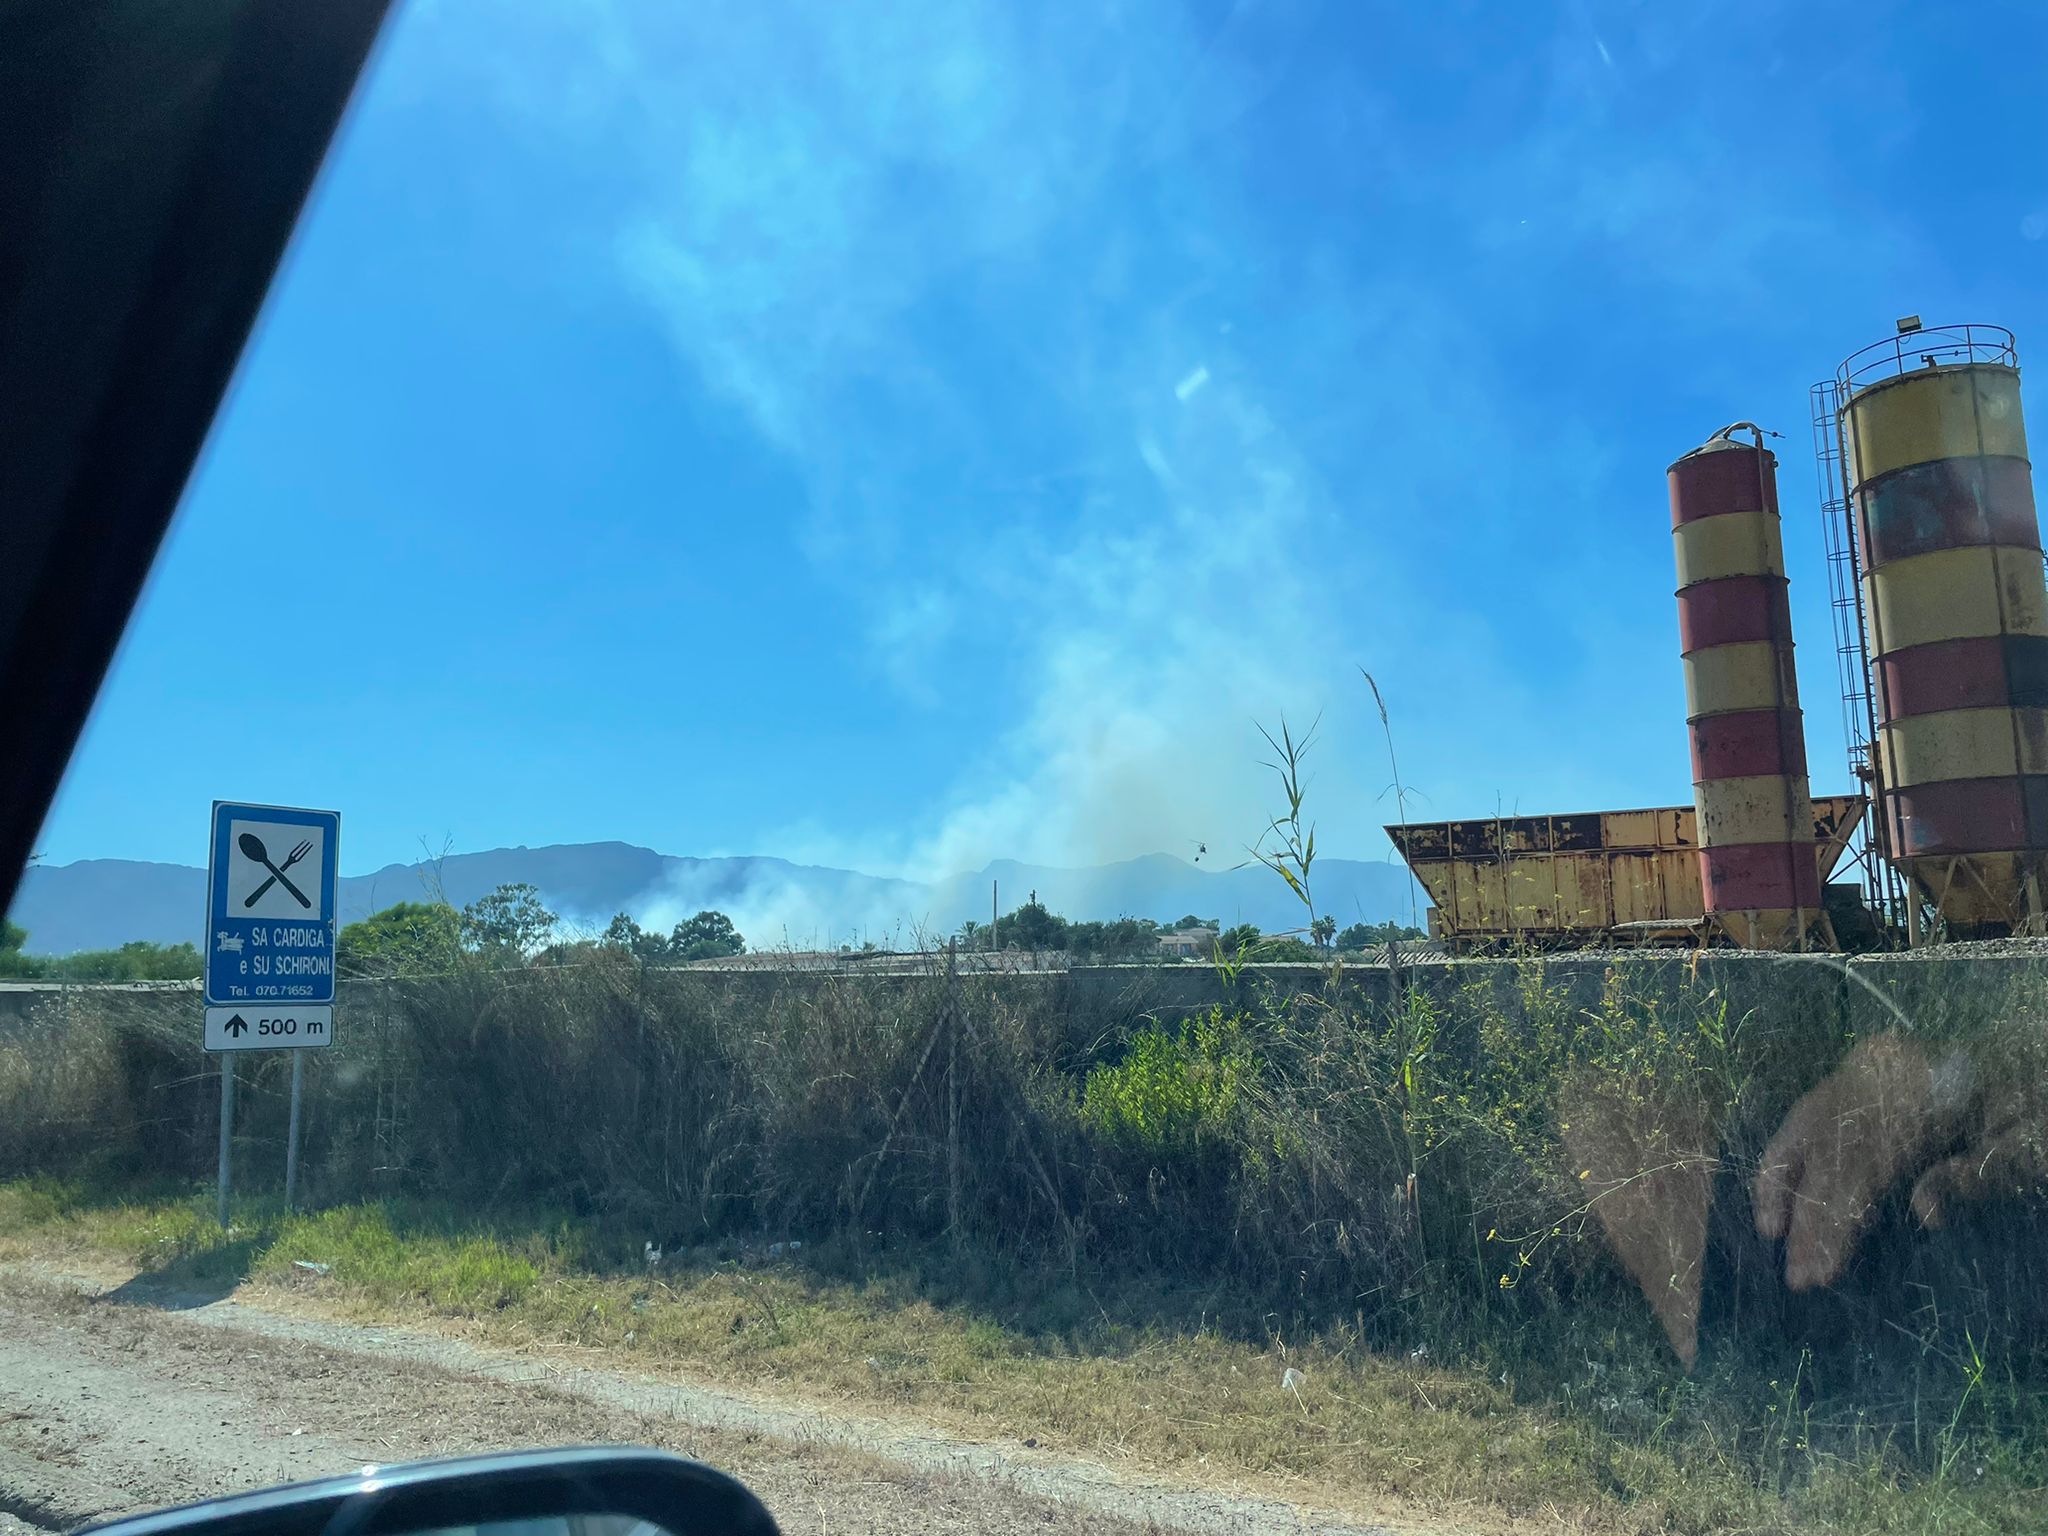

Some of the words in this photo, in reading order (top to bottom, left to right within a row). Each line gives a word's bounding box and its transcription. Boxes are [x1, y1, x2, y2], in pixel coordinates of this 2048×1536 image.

[252, 927, 268, 946] SA
[273, 928, 325, 947] CARDIGA
[240, 960, 247, 974] e
[254, 955, 269, 974] SU
[275, 955, 331, 975] SCHIRONI
[258, 1019, 297, 1035] 500
[307, 1022, 323, 1034] m
